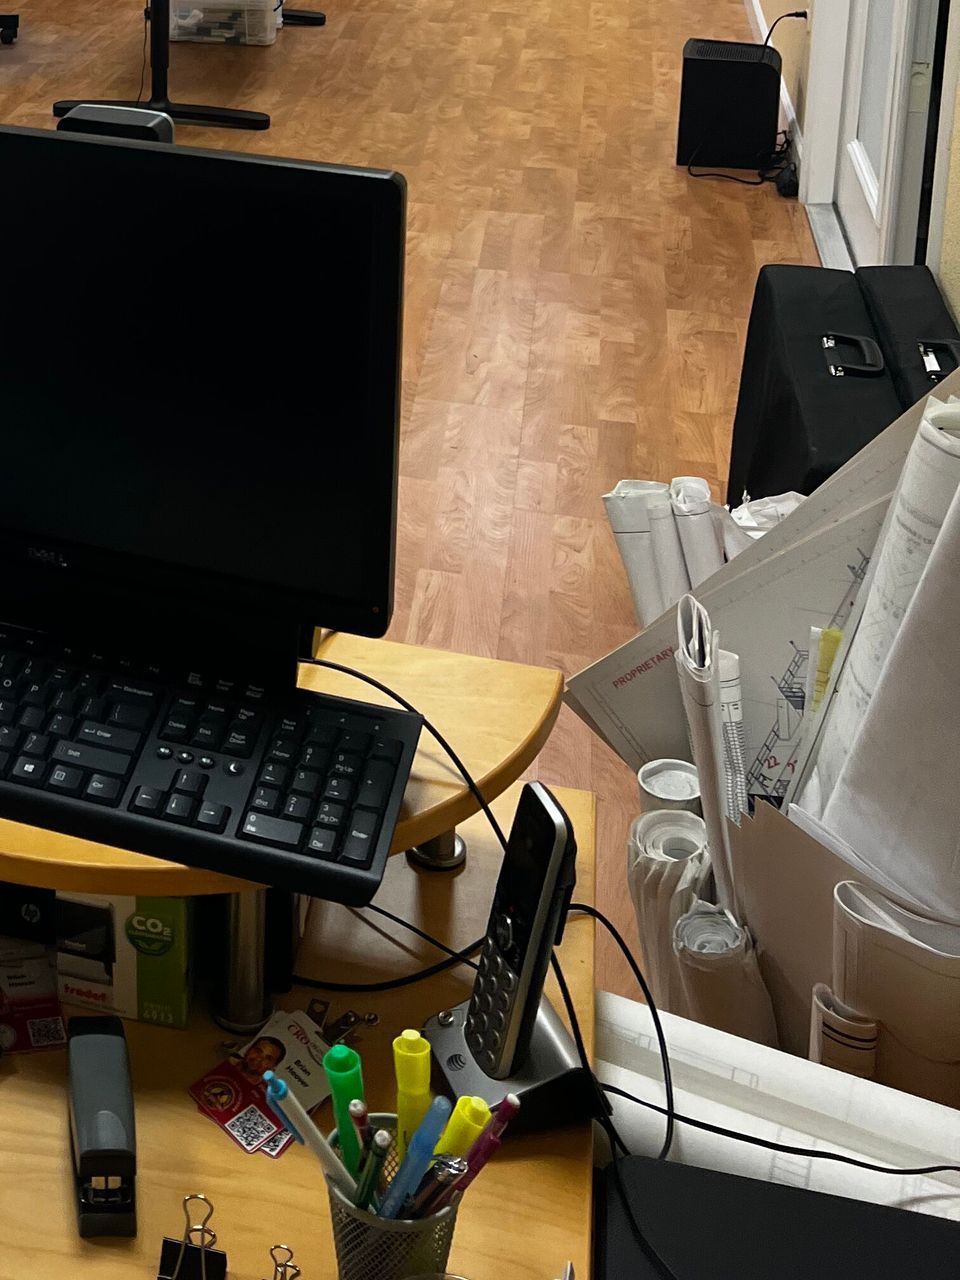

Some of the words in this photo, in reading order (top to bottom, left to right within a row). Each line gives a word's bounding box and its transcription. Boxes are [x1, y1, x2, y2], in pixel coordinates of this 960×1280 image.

[612, 646, 674, 689] PROPRIETARY
[285, 1064, 310, 1088] Hoover
[293, 1059, 312, 1077] Brian
